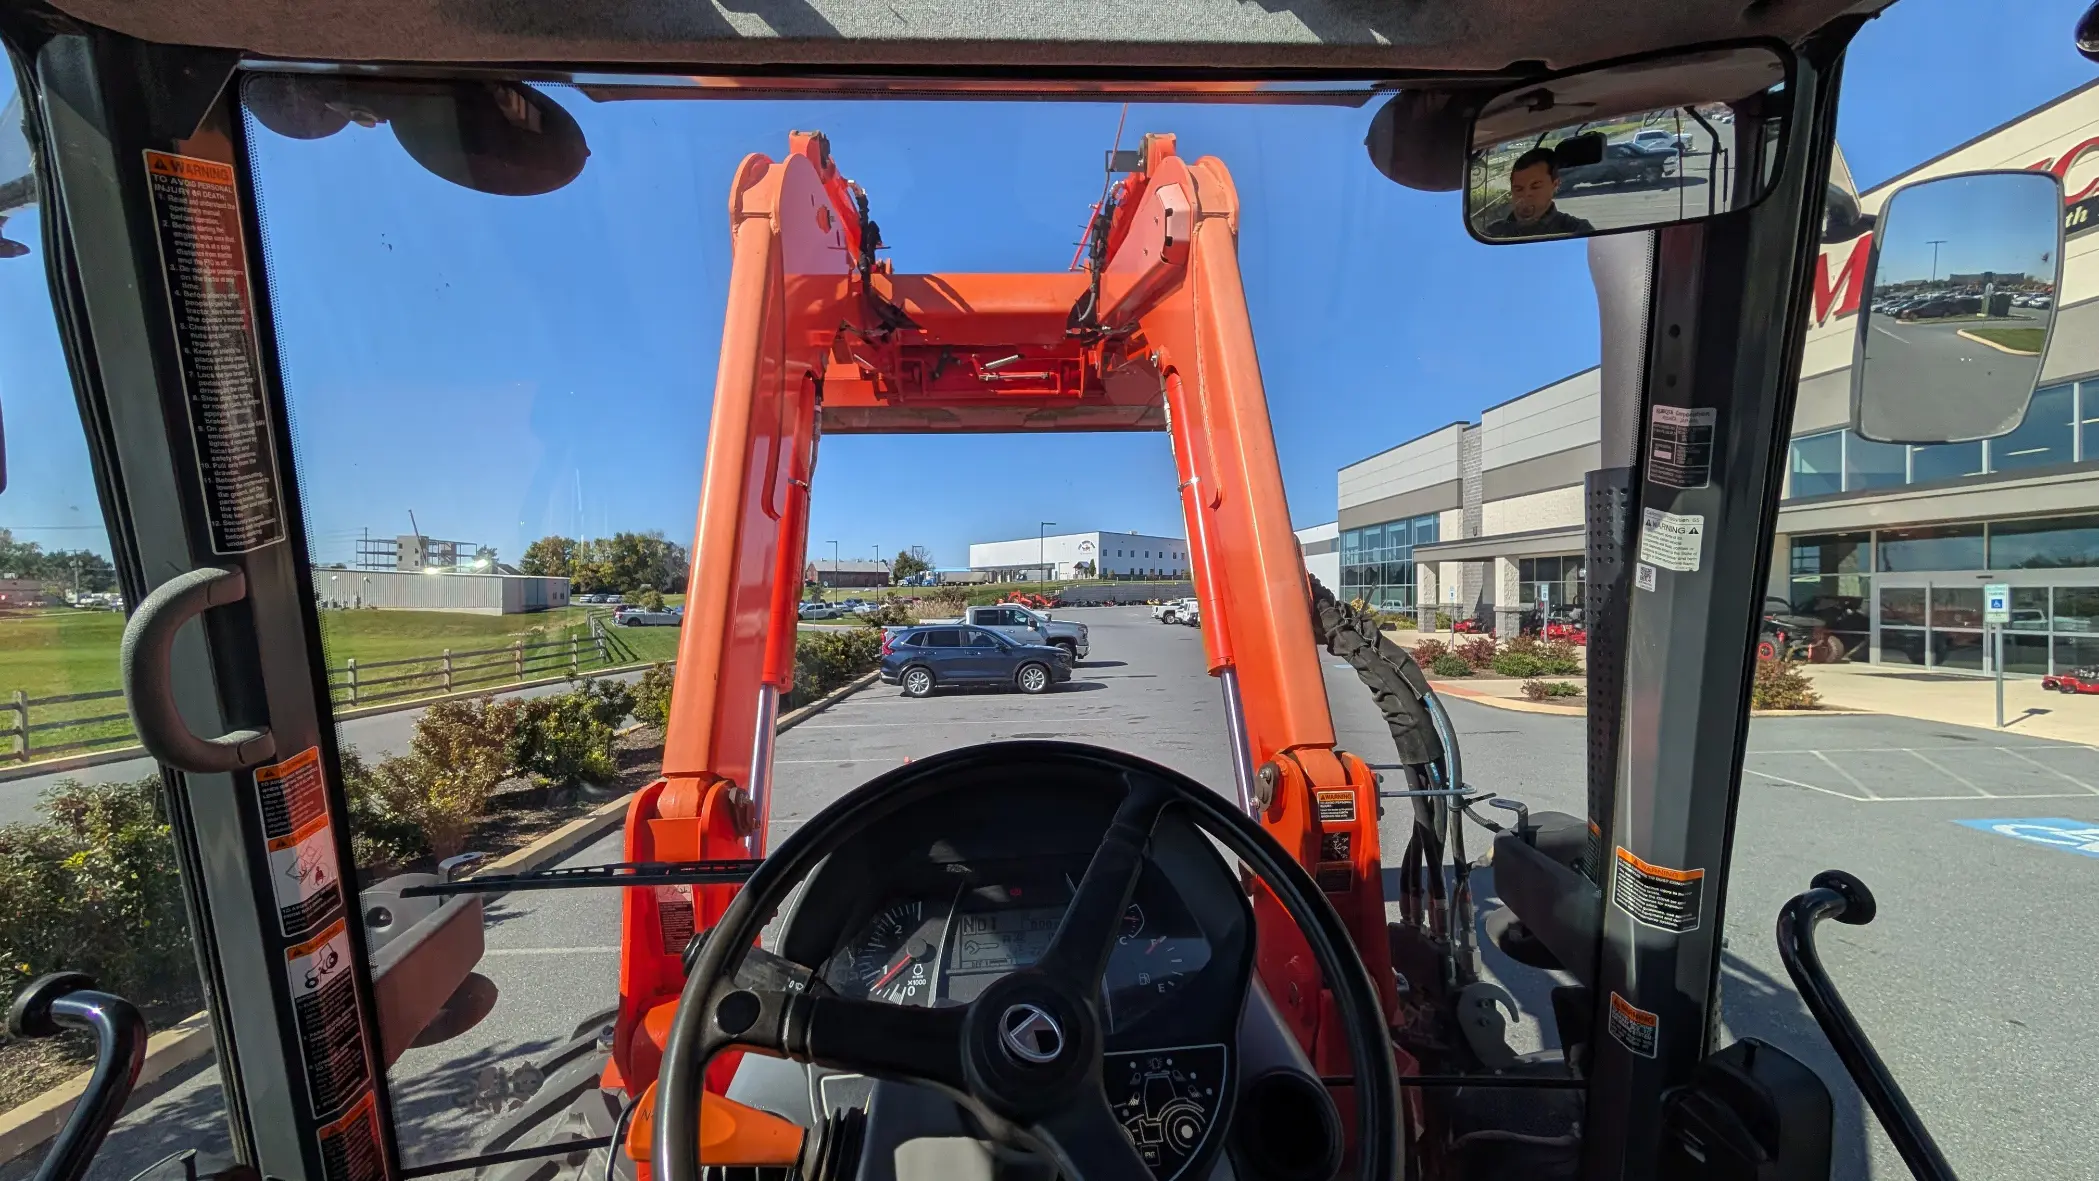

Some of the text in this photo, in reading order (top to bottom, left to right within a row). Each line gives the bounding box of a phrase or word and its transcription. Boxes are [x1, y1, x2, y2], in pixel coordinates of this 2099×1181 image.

[171, 160, 228, 179] WARNING
[152, 173, 233, 193] TO AVOID PERSONAL
[154, 183, 190, 196] INJURY
[1652, 520, 1686, 534] WARNING
[1641, 864, 1679, 879] WARNING
[894, 924, 903, 934] 2
[1120, 936, 1128, 945] C
[882, 964, 888, 975] 1
[907, 986, 916, 997] 0
[1157, 983, 1165, 993] E
